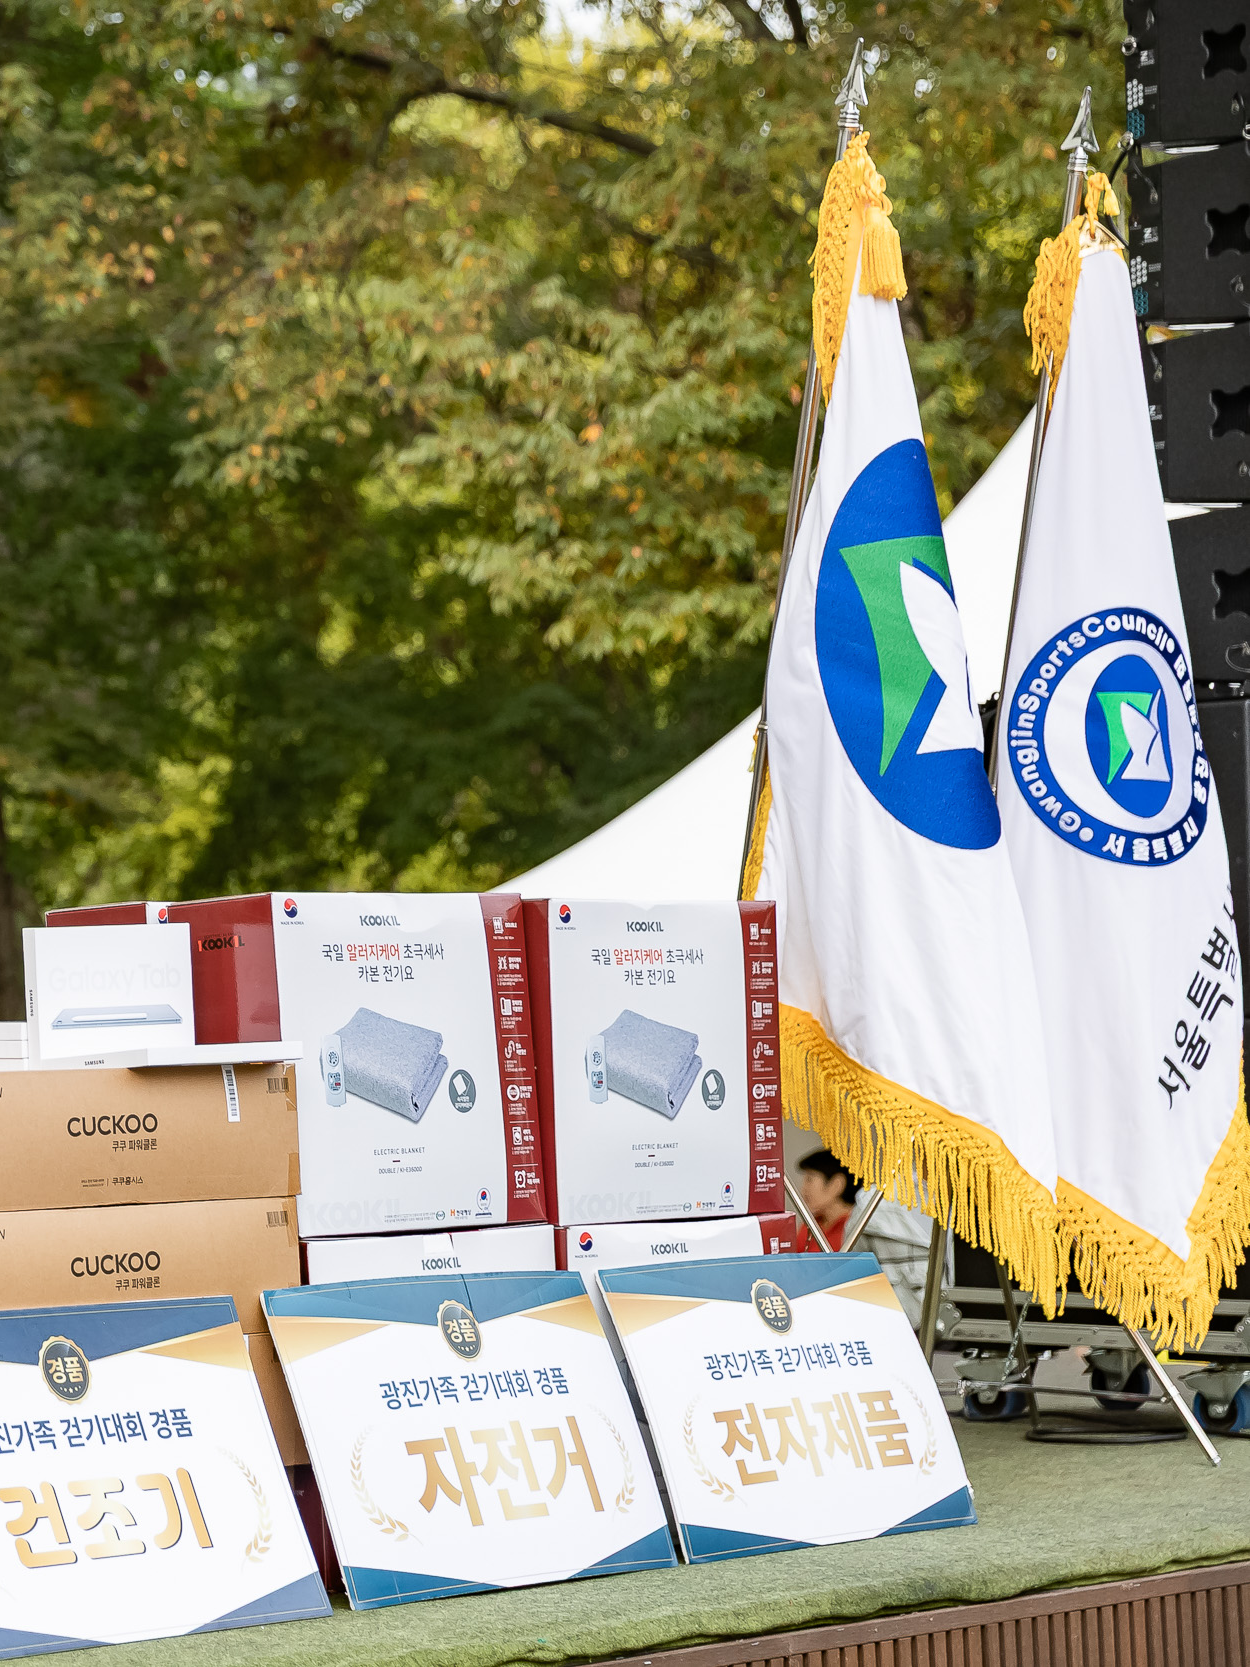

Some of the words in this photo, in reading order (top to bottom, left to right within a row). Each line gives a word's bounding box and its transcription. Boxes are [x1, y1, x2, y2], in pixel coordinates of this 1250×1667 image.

[359, 915, 400, 926] KOOKIL
[627, 922, 664, 932] KOOKIL
[322, 944, 344, 961] 국일
[347, 944, 400, 960] 알러지케어
[403, 943, 444, 960] 초극세사
[591, 949, 611, 965] 국일
[614, 949, 663, 965] 알러지케어
[666, 949, 703, 964] 초극세사
[49, 967, 135, 995] Galaxy
[138, 962, 182, 990] Tab
[358, 966, 379, 982] 카본
[382, 966, 414, 982] 전기요
[624, 970, 644, 985] 카본
[647, 969, 676, 985] 전기요
[67, 1113, 158, 1137] CUCKOO
[112, 1141, 126, 1152] 쿠쿠
[128, 1139, 157, 1151] 파워클론
[401, 1147, 425, 1155] BLANKET
[112, 1177, 143, 1185] 쿠쿠홈시스
[651, 1243, 688, 1255] KOOKIL
[70, 1251, 160, 1277] CUCKOO
[421, 1256, 462, 1271] KOOKIL
[115, 1280, 129, 1291] 쿠쿠
[132, 1276, 160, 1289] 파워클론
[757, 1296, 788, 1322] 경품
[442, 1317, 477, 1347] 경품
[705, 1352, 773, 1382] 광진가족
[777, 1343, 837, 1375] 걷기대회
[839, 1340, 873, 1368] 경품
[46, 1356, 83, 1385] 경품
[379, 1375, 459, 1410] 광진가족
[462, 1369, 530, 1402] 걷기대회
[534, 1367, 569, 1396] 경품
[61, 1411, 147, 1449] 걷기대회
[149, 1408, 194, 1441] 경품
[713, 1390, 913, 1487] 전자제품
[403, 1415, 606, 1528] 자전거
